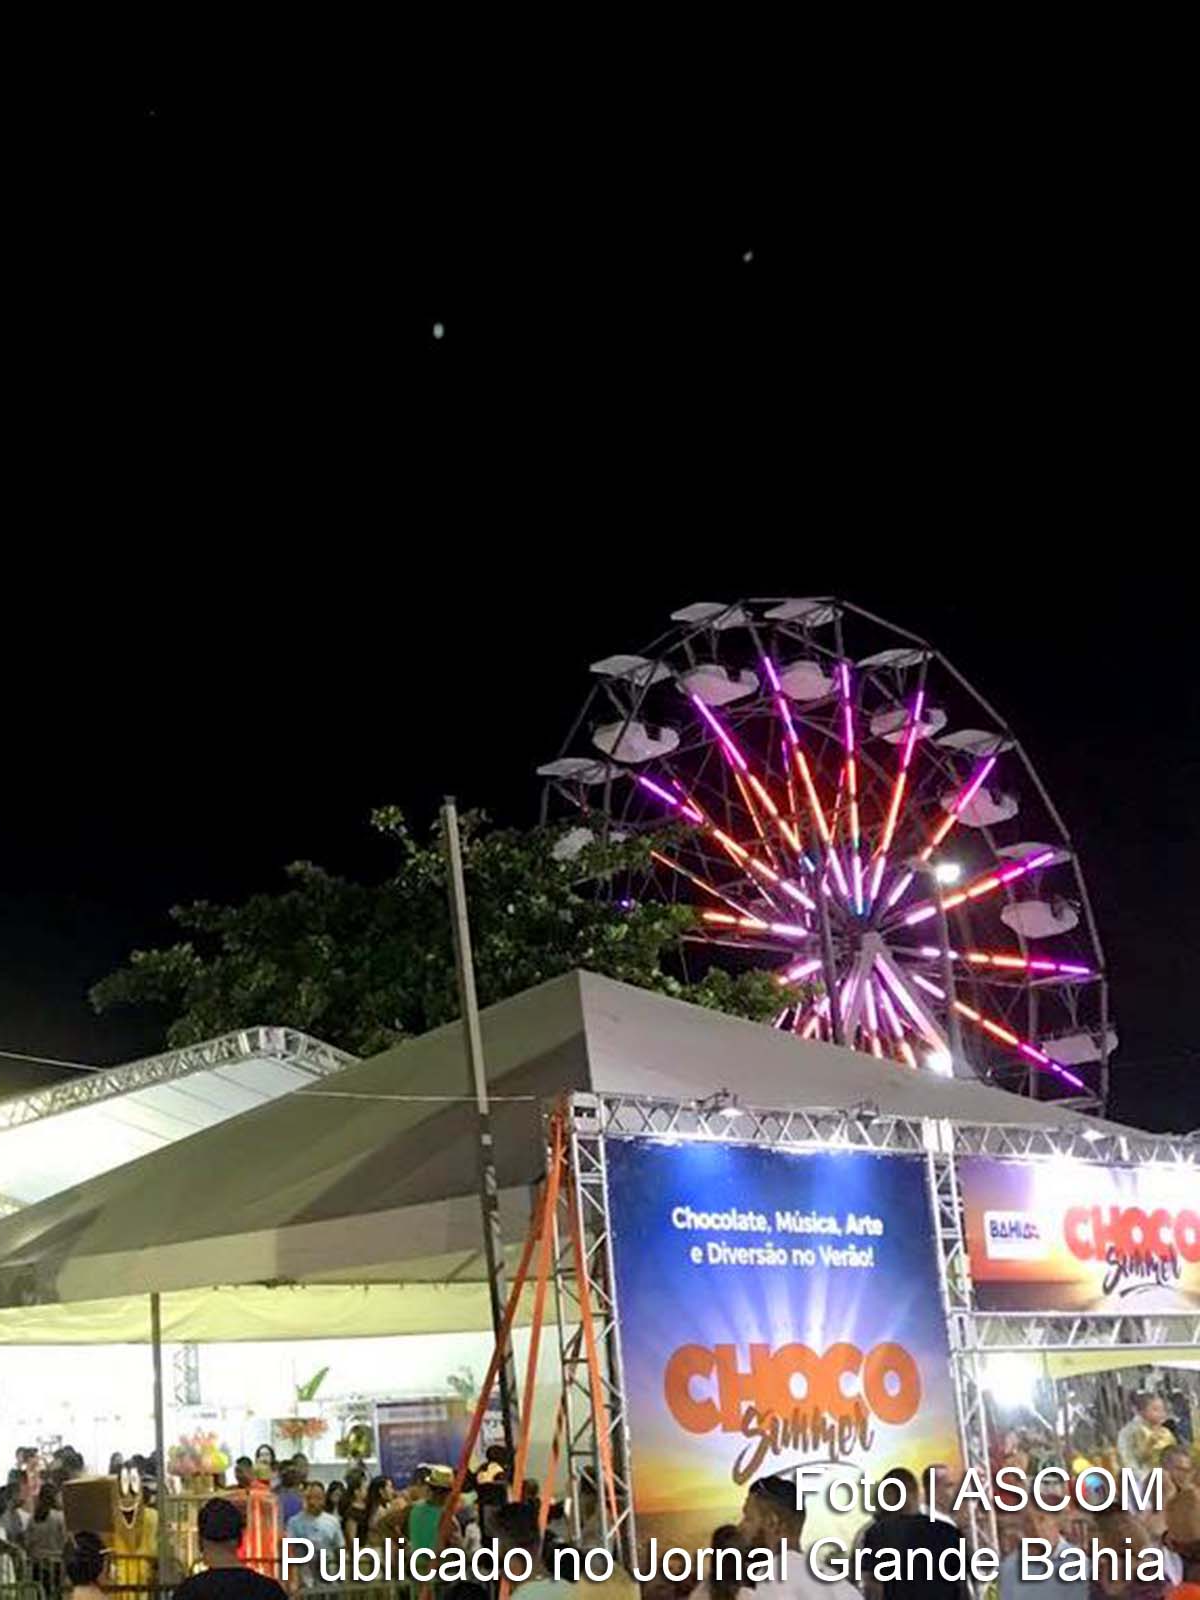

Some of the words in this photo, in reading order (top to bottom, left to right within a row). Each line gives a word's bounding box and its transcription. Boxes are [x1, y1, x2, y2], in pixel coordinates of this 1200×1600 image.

[672, 1205, 772, 1234] Chocolate,
[775, 1210, 843, 1237] Música,
[846, 1213, 883, 1236] Arte
[989, 1219, 1035, 1239] BAHIA
[1064, 1204, 1200, 1263] CHOCO
[690, 1245, 704, 1264] e
[707, 1242, 787, 1265] Diversão
[793, 1250, 816, 1265] no
[819, 1244, 875, 1268] Verão!
[1103, 1245, 1182, 1295] Summer
[664, 1342, 922, 1434] CHOCO
[732, 1402, 875, 1486] Summer
